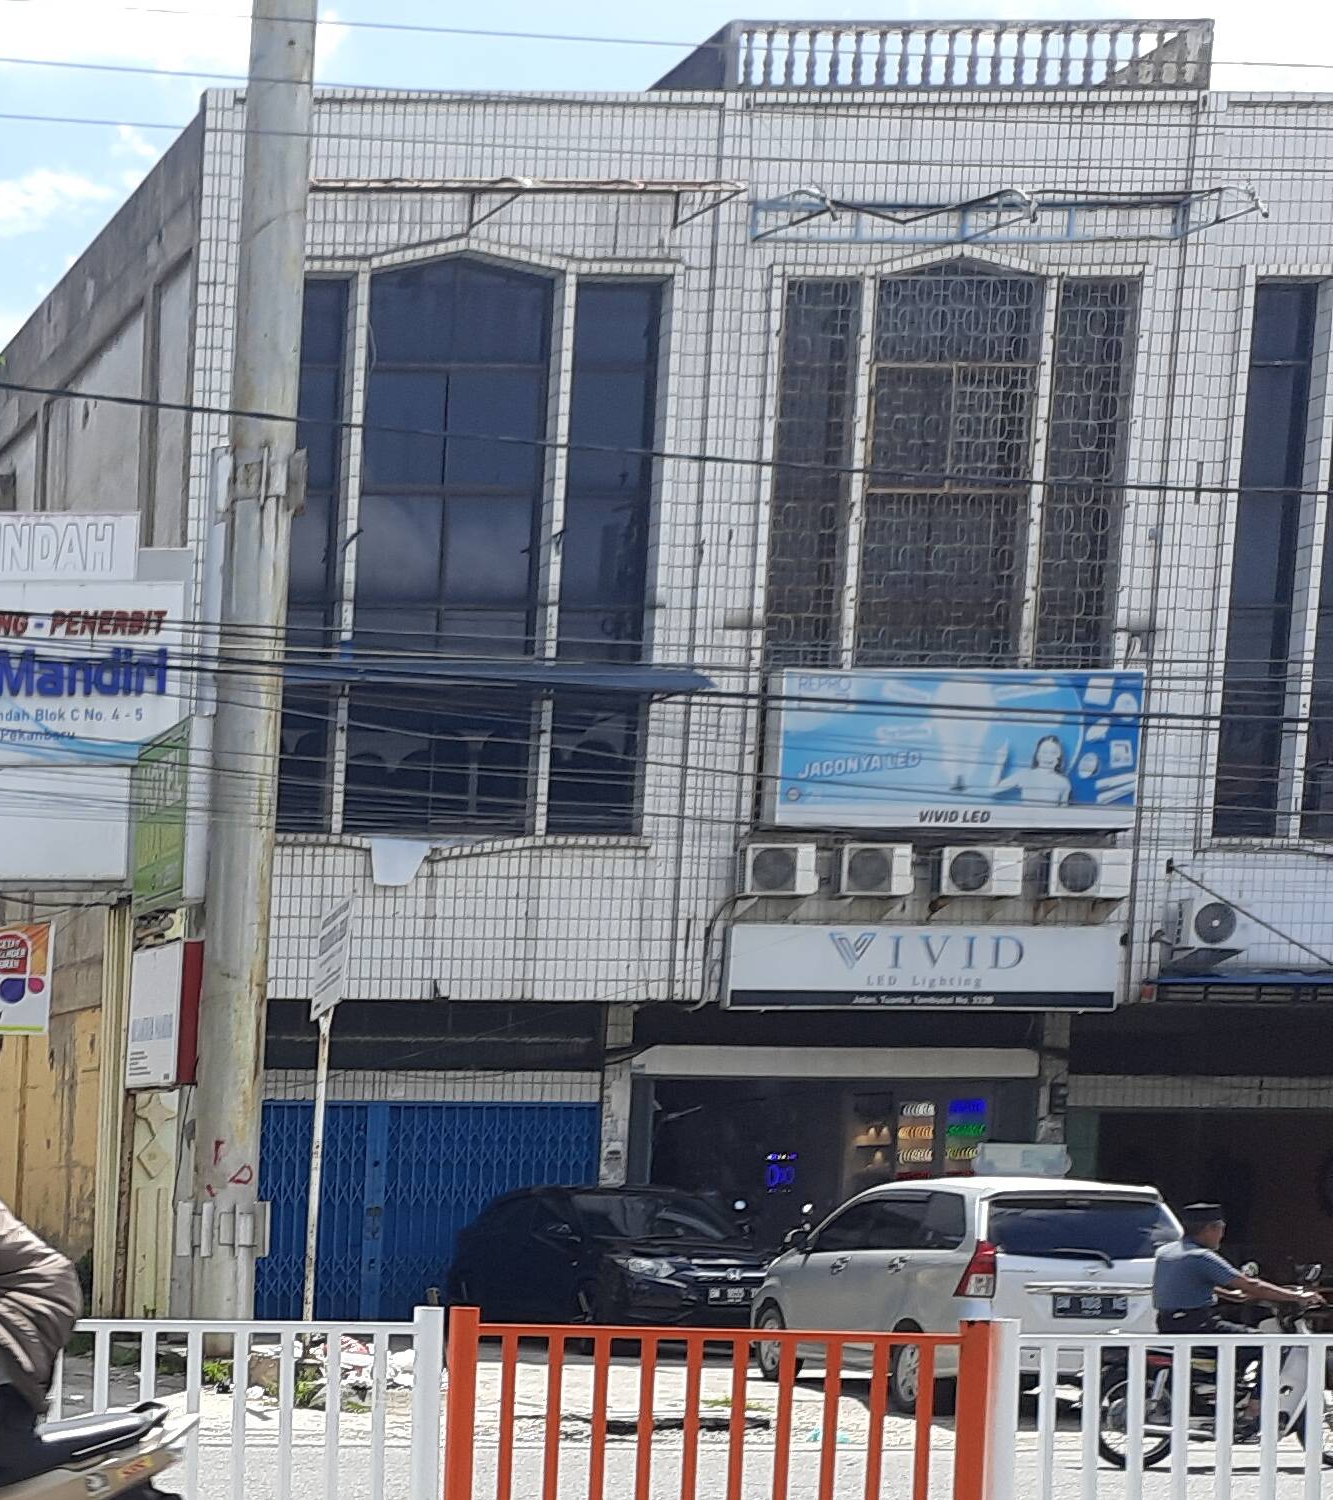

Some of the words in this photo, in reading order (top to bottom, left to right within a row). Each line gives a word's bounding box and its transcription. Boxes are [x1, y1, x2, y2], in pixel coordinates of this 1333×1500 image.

[49, 610, 167, 637] PENERBIT
[35, 709, 65, 722] Blok
[71, 709, 80, 721] C
[84, 709, 107, 721] No.
[134, 708, 144, 721] 5
[887, 751, 922, 771] LED
[918, 810, 958, 825] VIVID
[961, 810, 992, 825] LED
[829, 932, 1025, 970] VIVID
[866, 975, 897, 987] LED
[911, 975, 982, 989] Lighting
